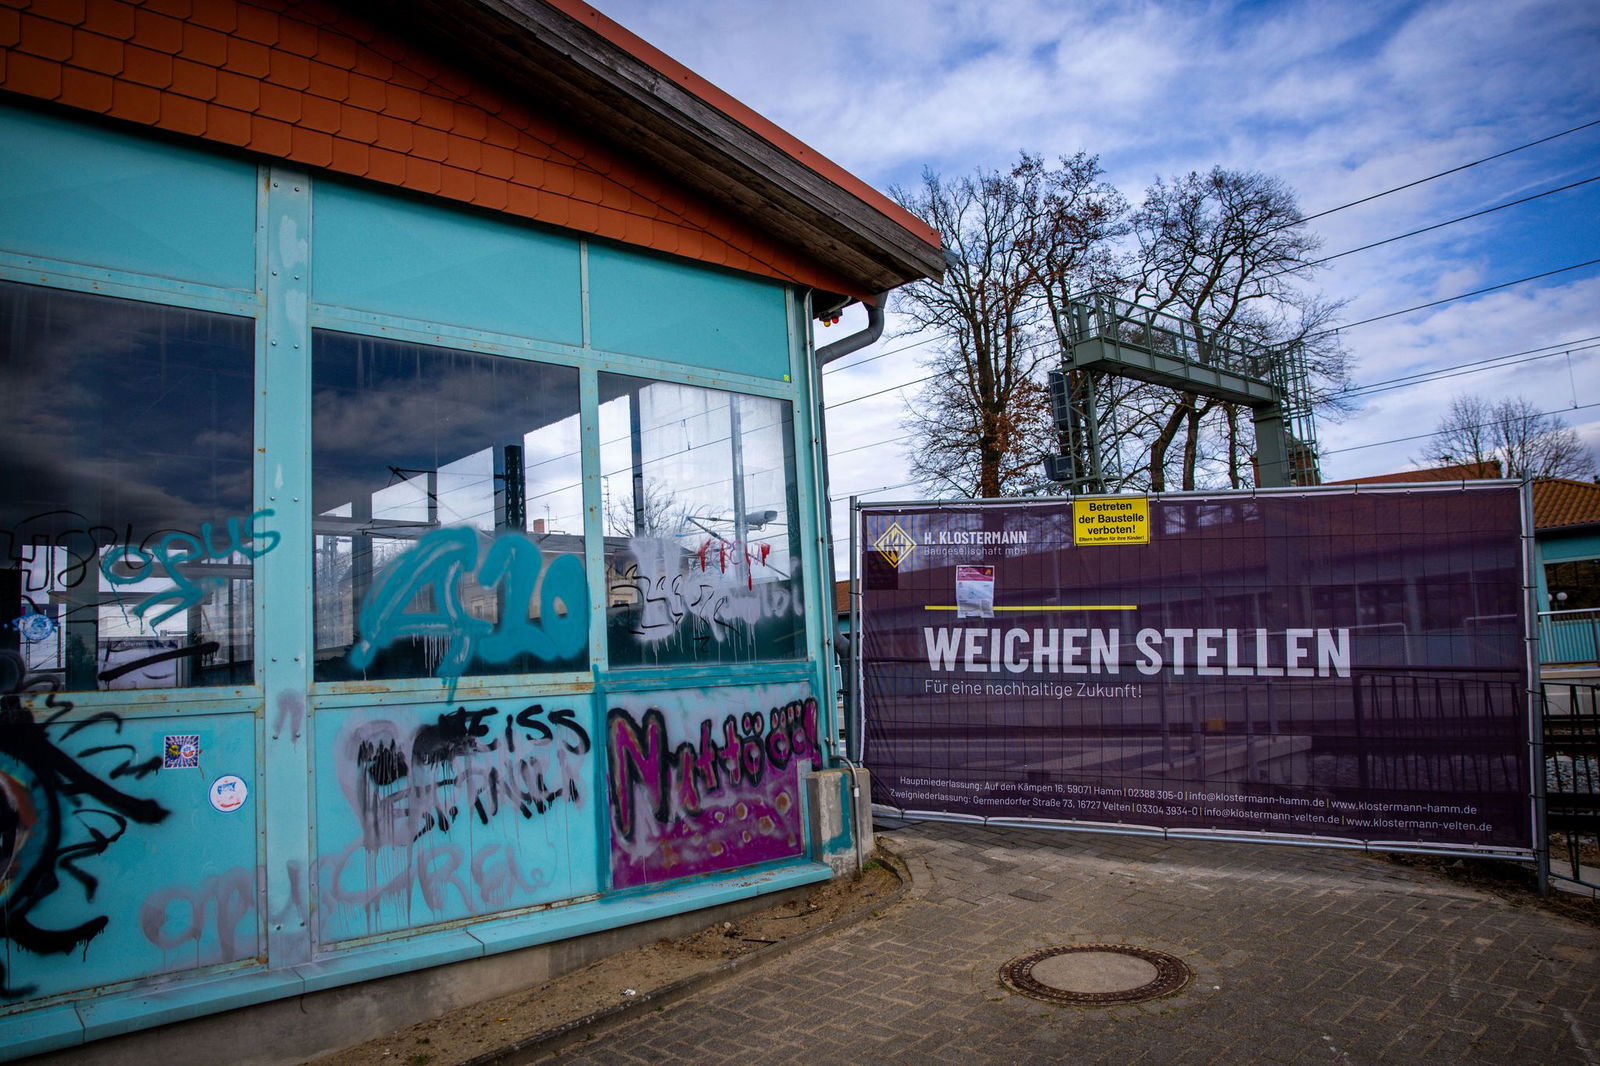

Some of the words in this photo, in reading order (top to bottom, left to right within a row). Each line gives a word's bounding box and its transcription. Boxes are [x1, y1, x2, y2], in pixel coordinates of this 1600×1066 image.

[1089, 502, 1132, 512] Betreten
[1078, 515, 1095, 524] der
[1098, 513, 1144, 523] Baustelle
[1087, 524, 1136, 535] verboten!
[924, 532, 936, 545] H.
[939, 530, 1028, 545] KLOSTERMANN
[924, 546, 1002, 558] Baugesellschaft
[1005, 546, 1028, 556] mbH
[924, 627, 1120, 675] WEICHEN
[1135, 628, 1351, 678] STELLEN
[925, 679, 948, 694] Für
[952, 681, 982, 695] eine
[986, 681, 1073, 700] nachhaltige
[1077, 682, 1143, 699] Zukunft!
[900, 776, 983, 792] Hauptniederlassung:
[984, 782, 998, 791] Auf
[1000, 782, 1016, 791] den
[1018, 782, 1053, 794] Kämpen
[1054, 784, 1065, 794] 16,
[1067, 785, 1092, 794] 59071
[1093, 787, 1122, 797] Hamm
[1128, 788, 1155, 798] 02388
[1157, 790, 1184, 800] 305-0
[1189, 791, 1325, 807] info@klostermann-hamm.de
[1330, 800, 1477, 815] www.klostermann-hamm.de
[890, 788, 972, 804] Zweigniederlassung:
[973, 795, 1031, 806] Germendorfer
[1032, 797, 1061, 807] Straße
[1063, 799, 1075, 808] 73,
[1077, 800, 1101, 810] 16727
[1102, 801, 1131, 811] Velten
[1136, 803, 1164, 814] 03304
[1165, 805, 1198, 816] 3934-0
[1203, 806, 1340, 824] info@klostermann-velten.de
[1346, 817, 1492, 832] www.klostermann-velten.de
